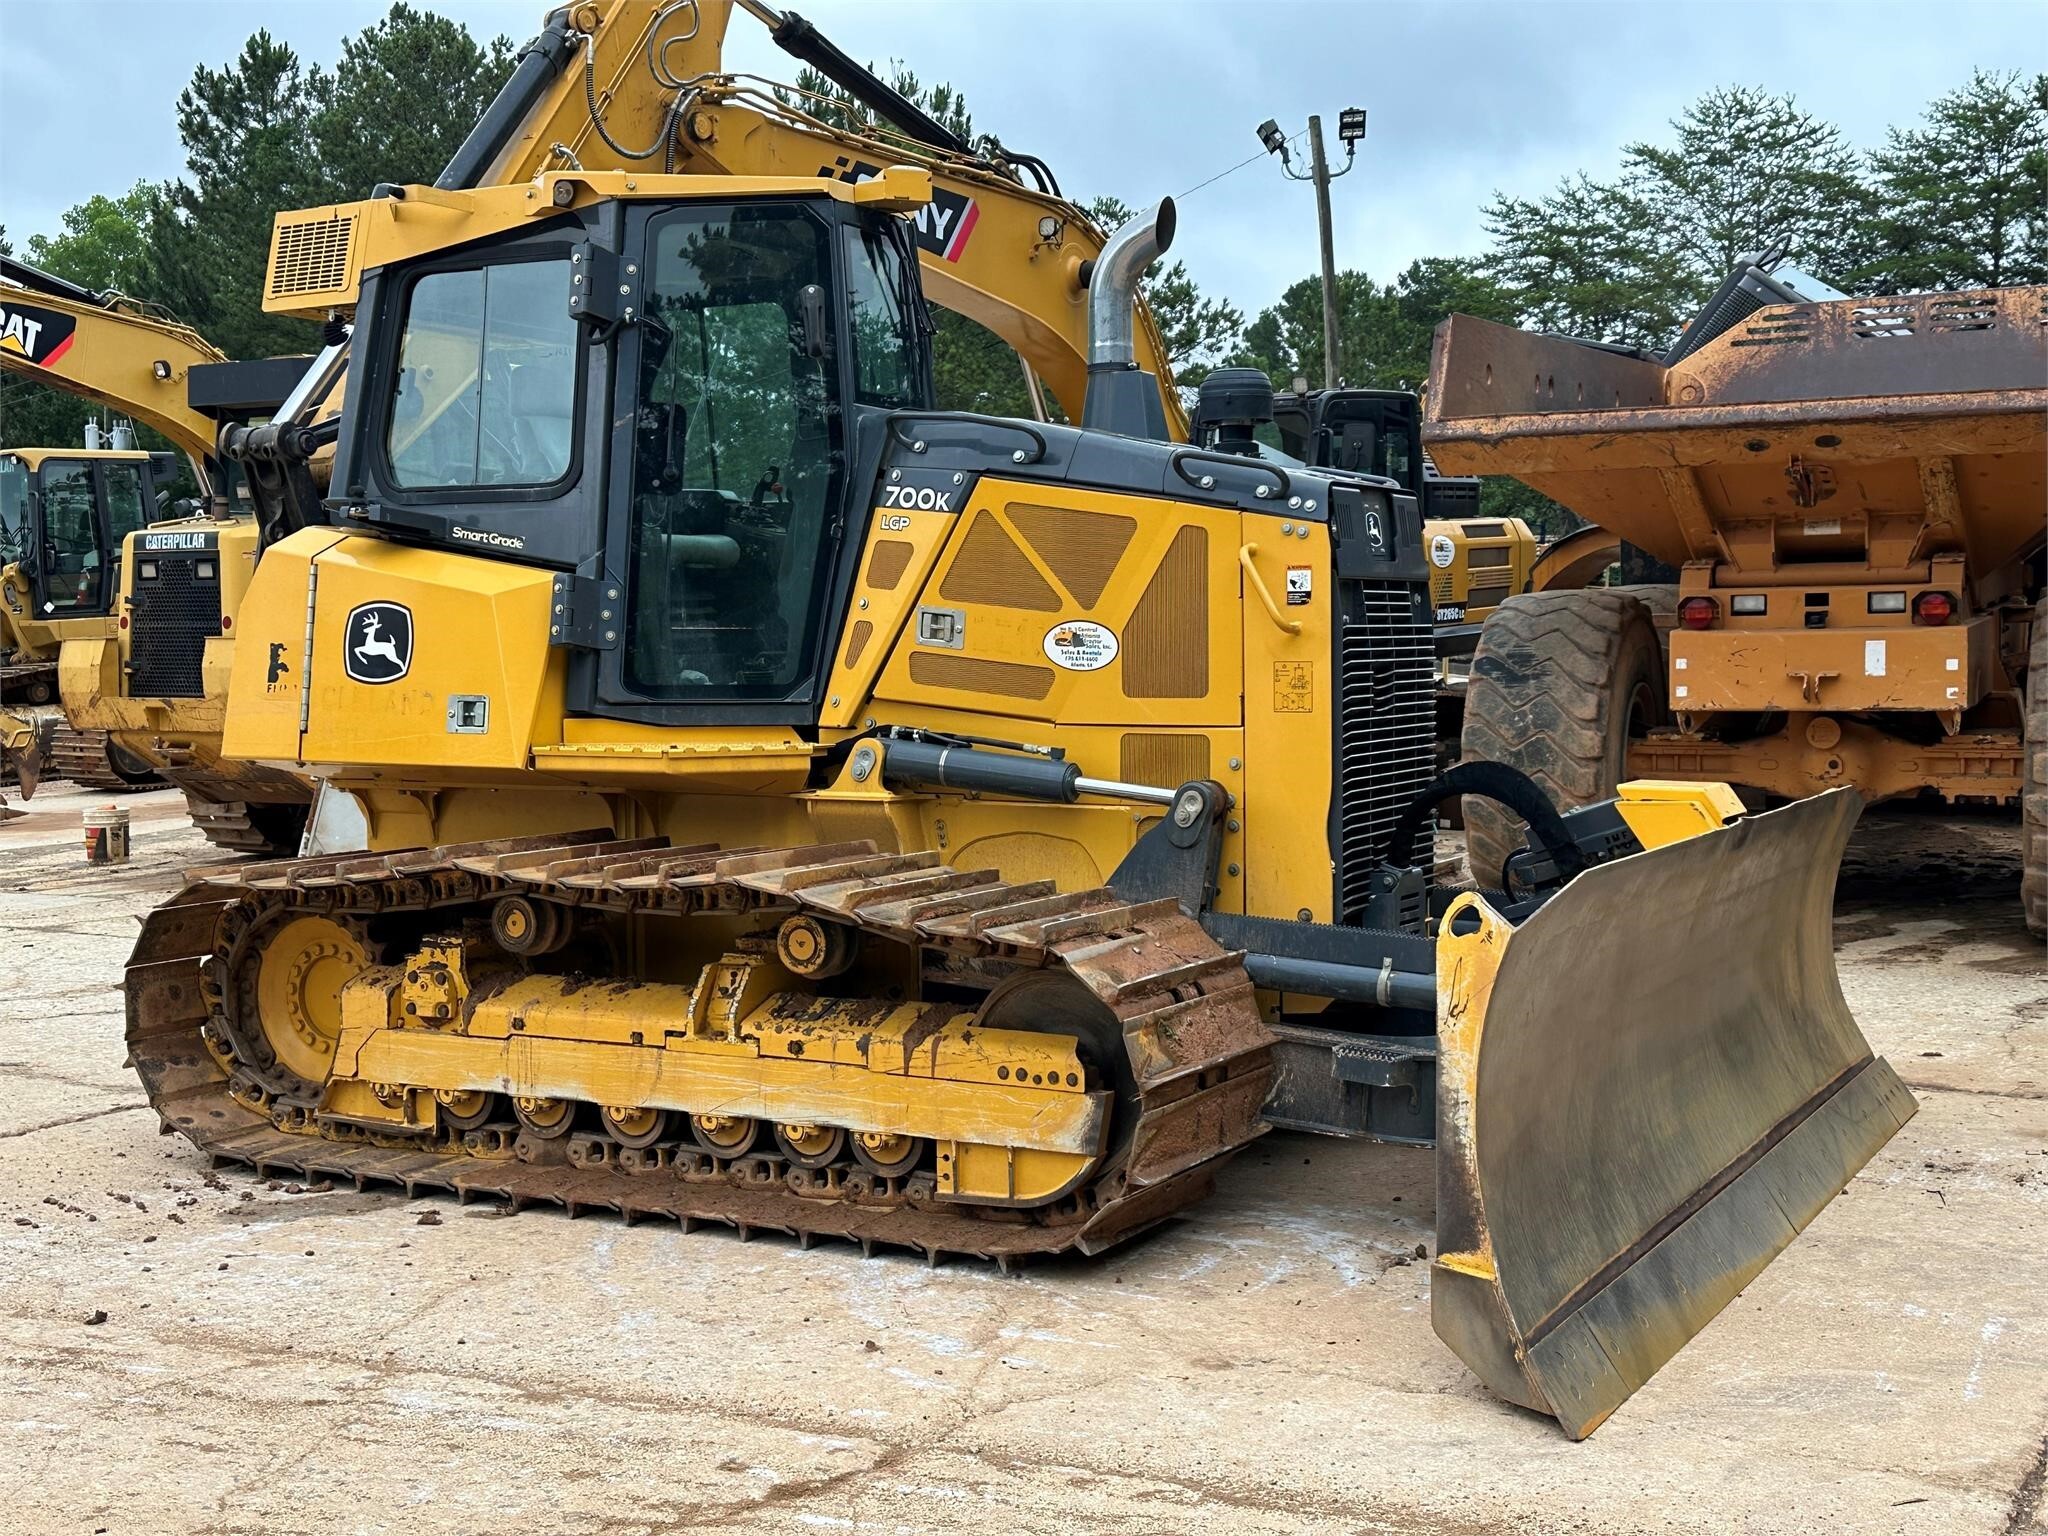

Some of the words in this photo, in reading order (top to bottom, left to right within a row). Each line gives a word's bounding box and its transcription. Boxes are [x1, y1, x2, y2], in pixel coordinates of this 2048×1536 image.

[885, 486, 951, 511] 700K
[881, 515, 910, 530] LGP
[145, 533, 205, 549] CATERPILLAR
